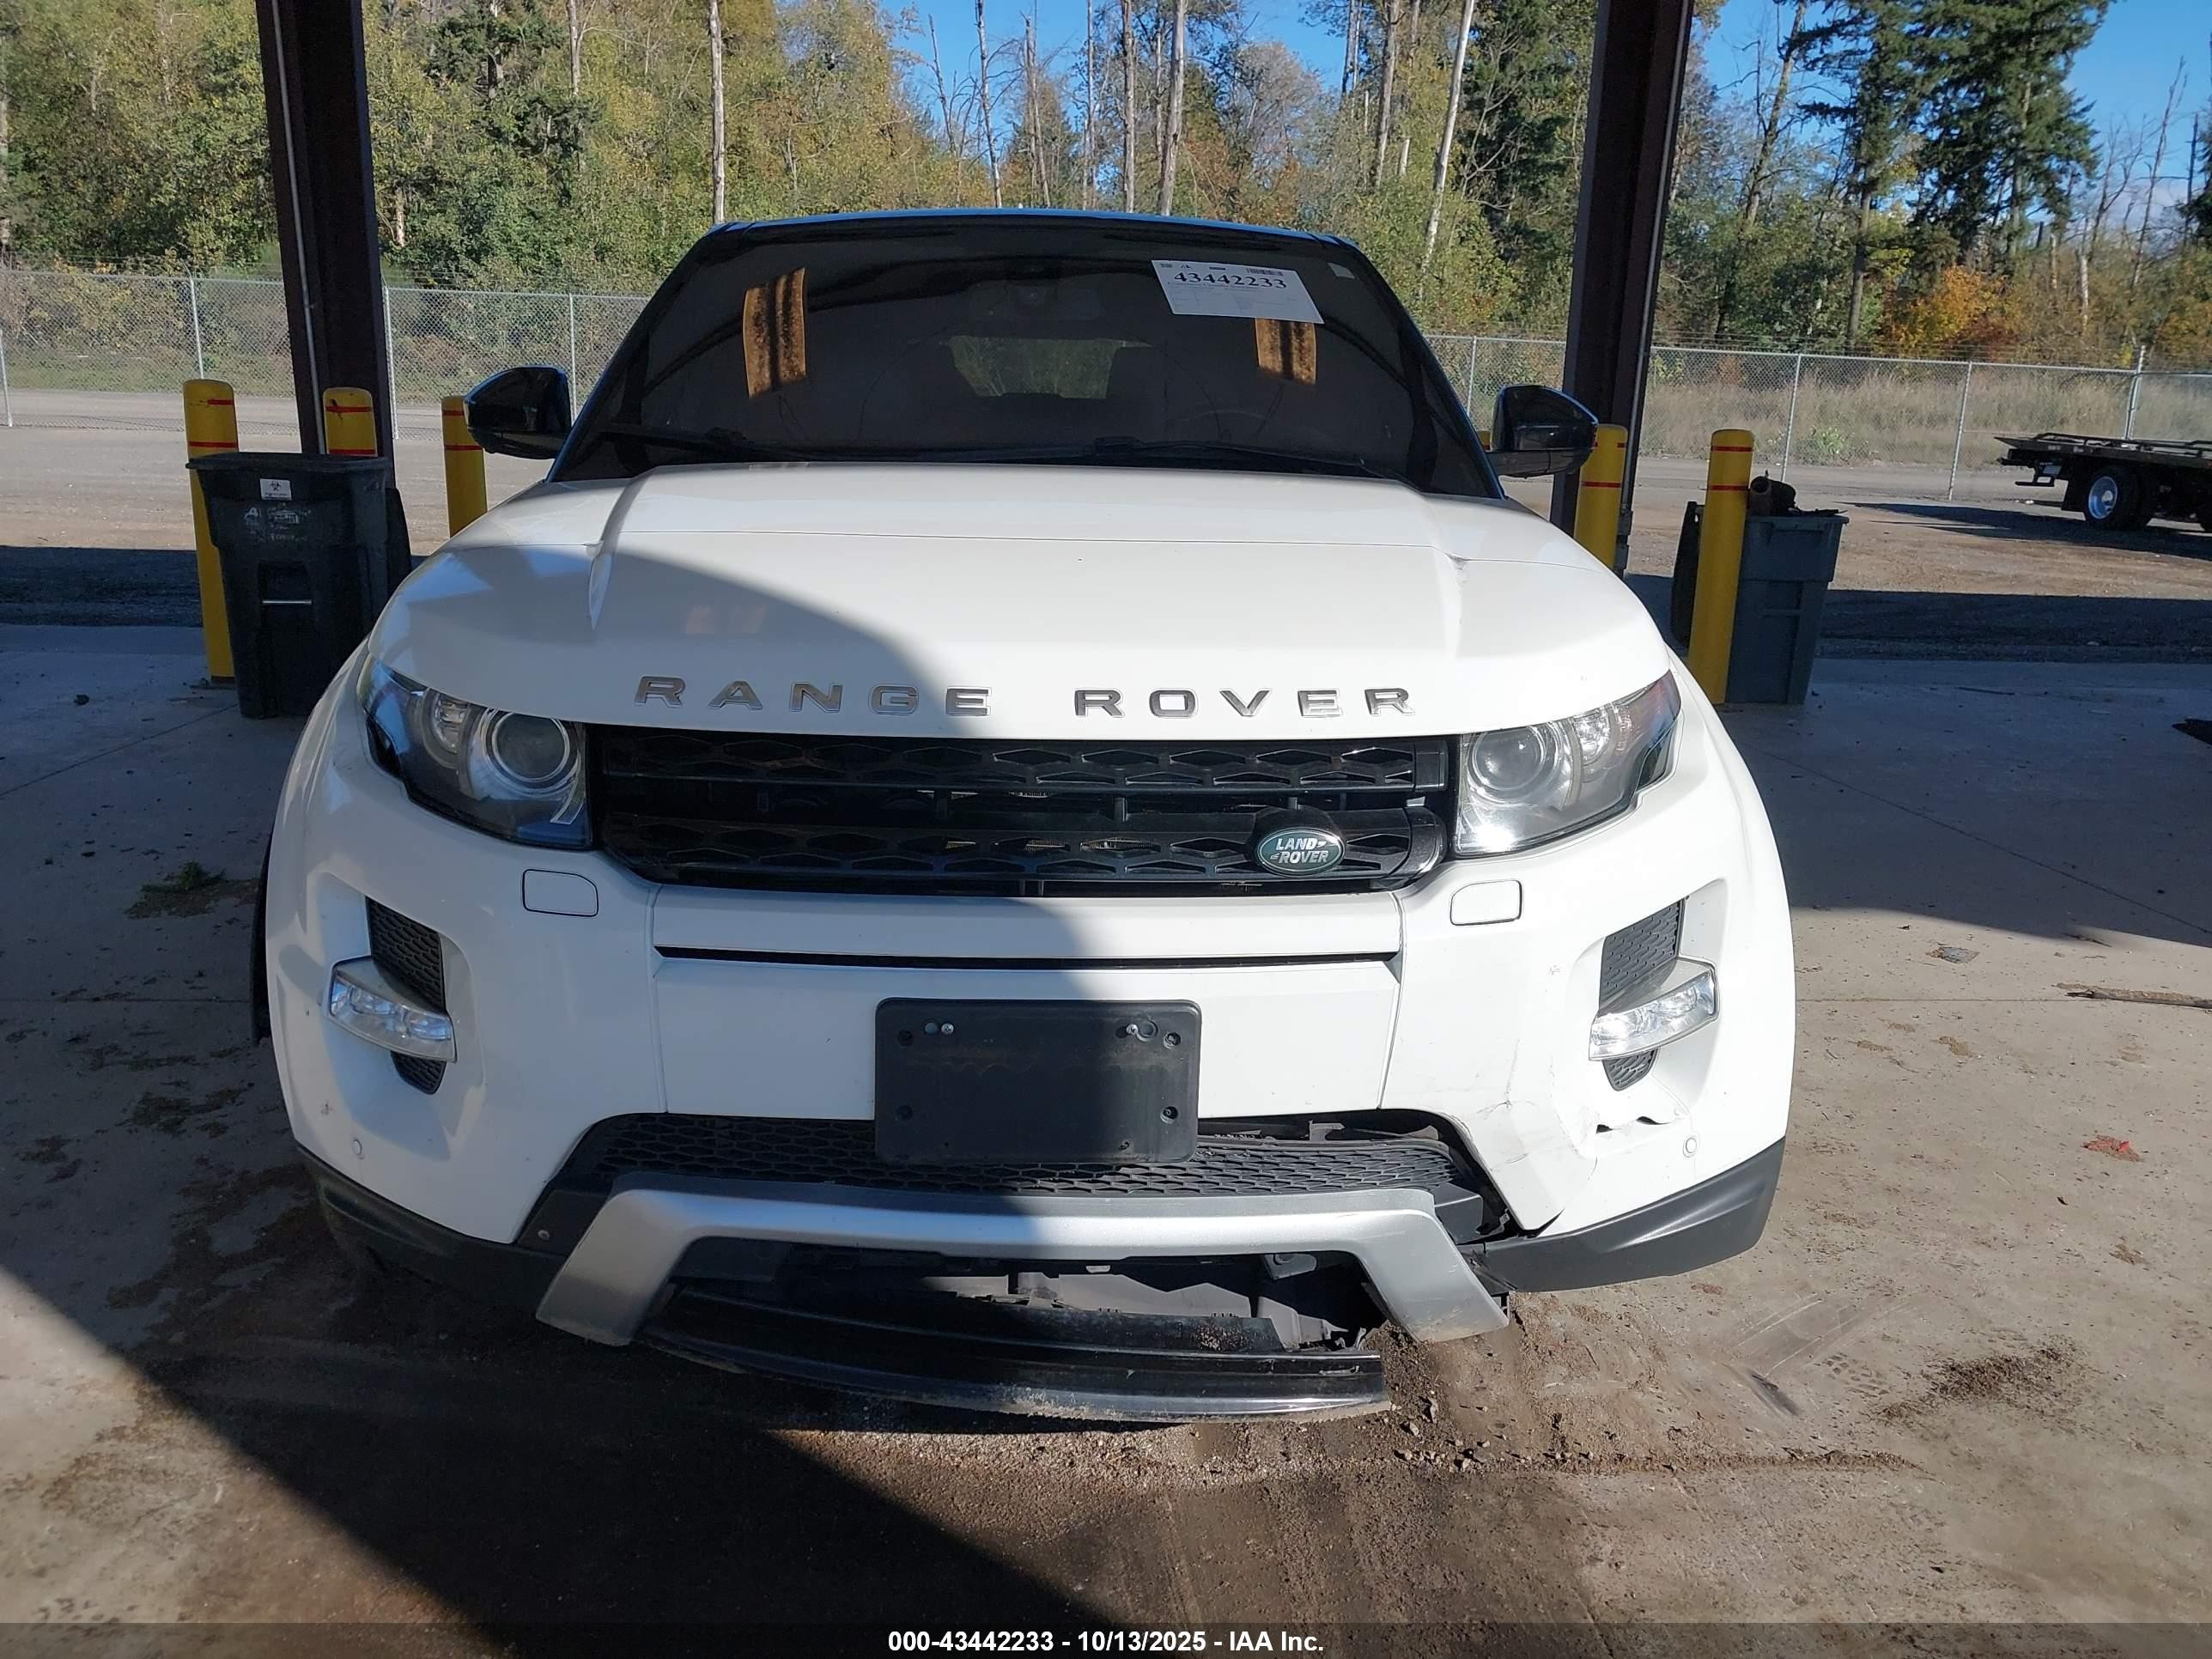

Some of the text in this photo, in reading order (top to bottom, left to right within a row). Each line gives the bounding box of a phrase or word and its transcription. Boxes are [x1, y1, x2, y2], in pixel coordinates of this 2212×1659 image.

[1174, 271, 1287, 289] 43442233
[633, 674, 1417, 719] RANGE ROVER
[1276, 838, 1318, 850] LAND
[1278, 851, 1329, 863] ROVER
